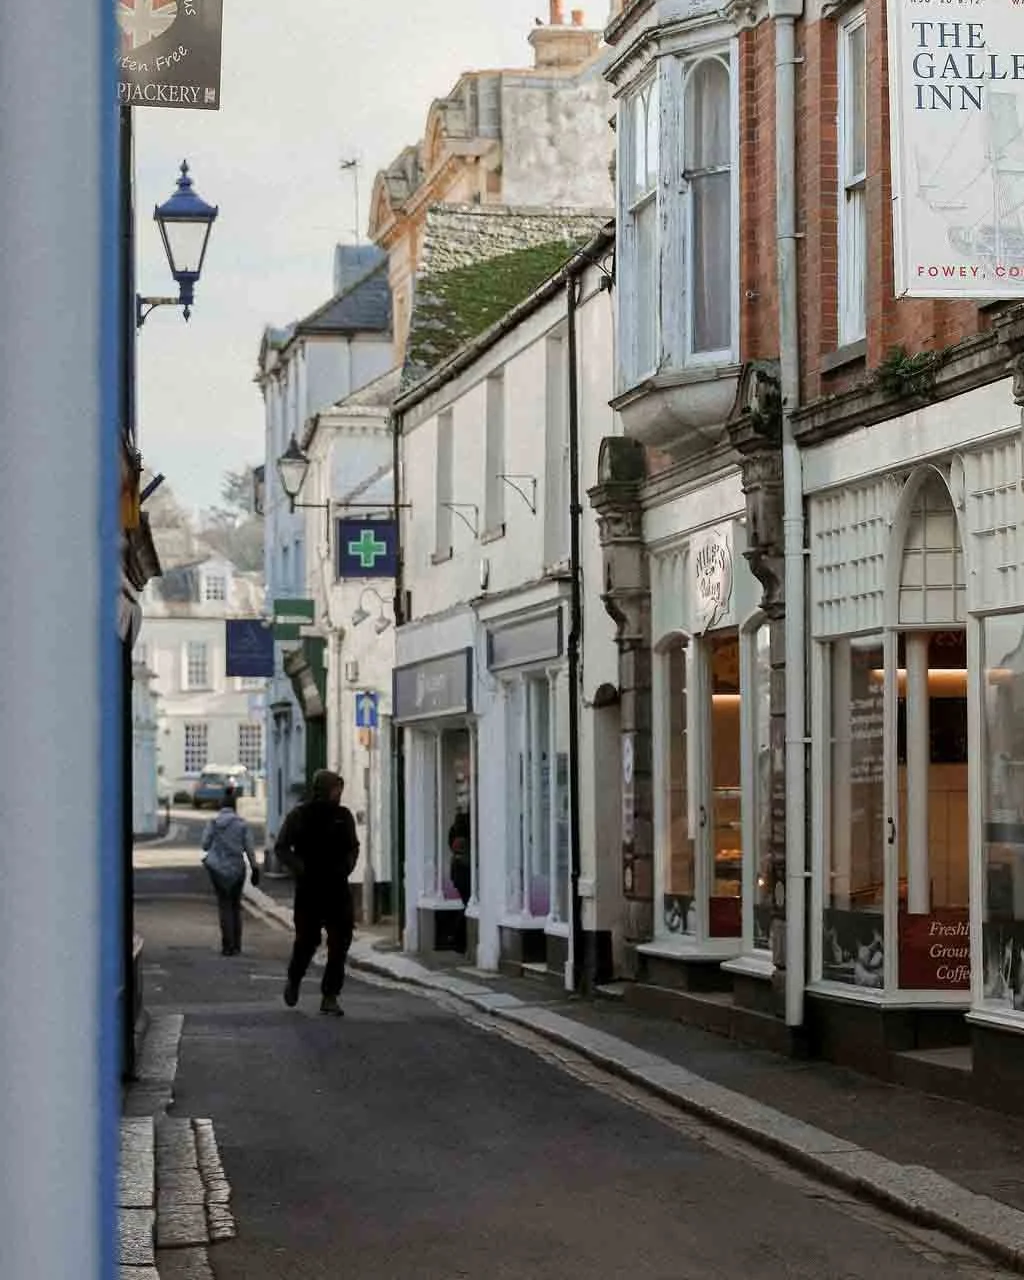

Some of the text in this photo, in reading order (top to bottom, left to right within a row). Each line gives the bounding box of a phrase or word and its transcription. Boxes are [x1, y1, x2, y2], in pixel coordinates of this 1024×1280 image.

[183, 0, 197, 16] us
[911, 22, 986, 48] THE
[156, 45, 188, 71] Free
[914, 84, 985, 111] INN
[917, 265, 986, 279] FOWEY,
[928, 920, 970, 939] Freshl
[936, 964, 971, 983] Coffe
